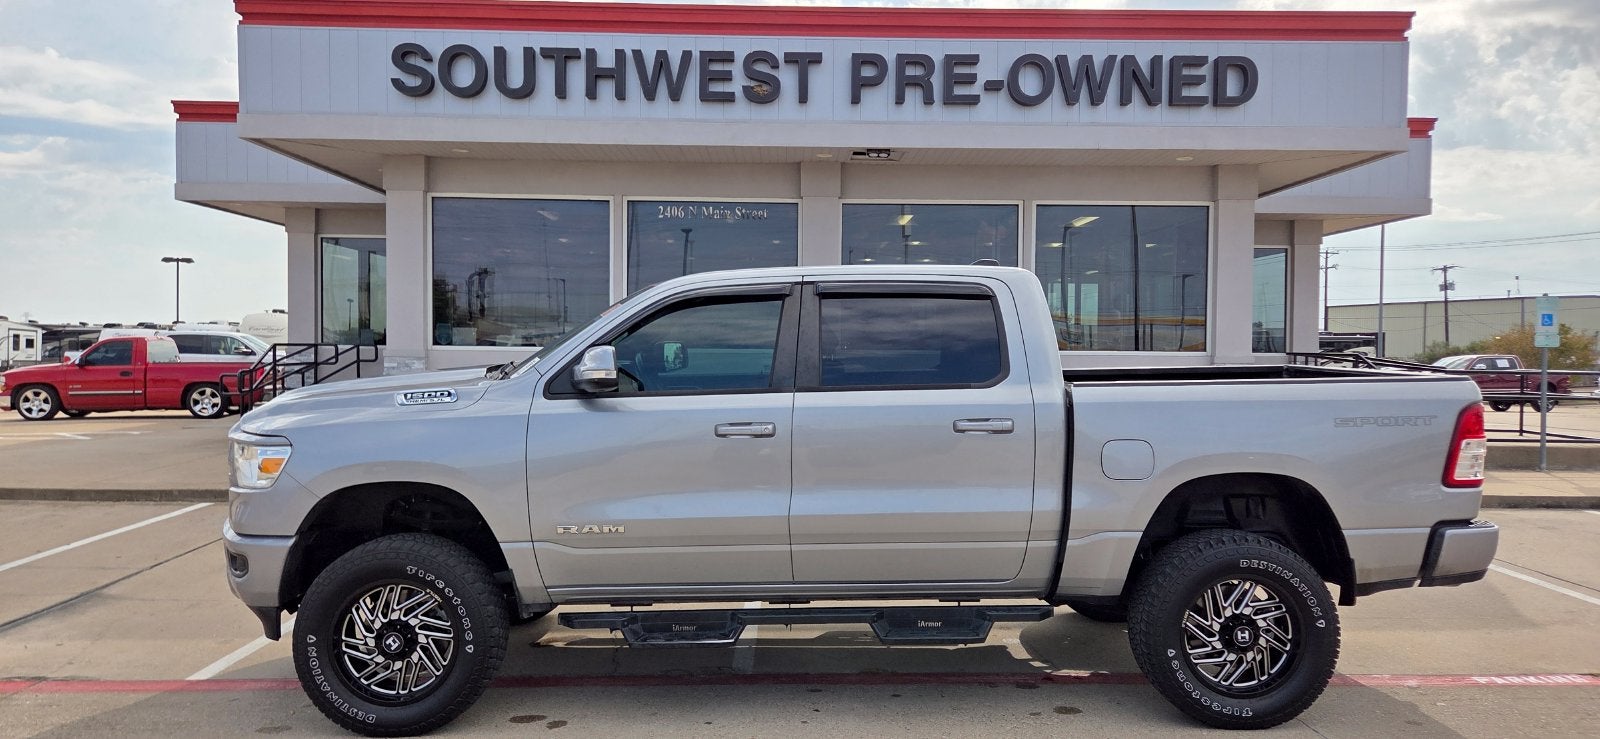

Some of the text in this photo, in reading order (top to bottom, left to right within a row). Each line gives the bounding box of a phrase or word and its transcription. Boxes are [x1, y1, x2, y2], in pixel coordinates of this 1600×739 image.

[391, 42, 1259, 107] SOUTHWEST PRE-OWNED
[658, 206, 768, 220] 2406 N Main Street
[406, 391, 448, 399] 1500
[1334, 415, 1438, 428] SPORT
[556, 524, 625, 535] RAM
[1239, 559, 1323, 618] DESTINATION
[406, 565, 473, 641] Firestone
[672, 624, 697, 632] iArmor
[918, 620, 943, 628] iArmor
[308, 646, 377, 724] DESTINATION
[1471, 675, 1590, 684] PARKING
[1171, 660, 1253, 717] Firestone
